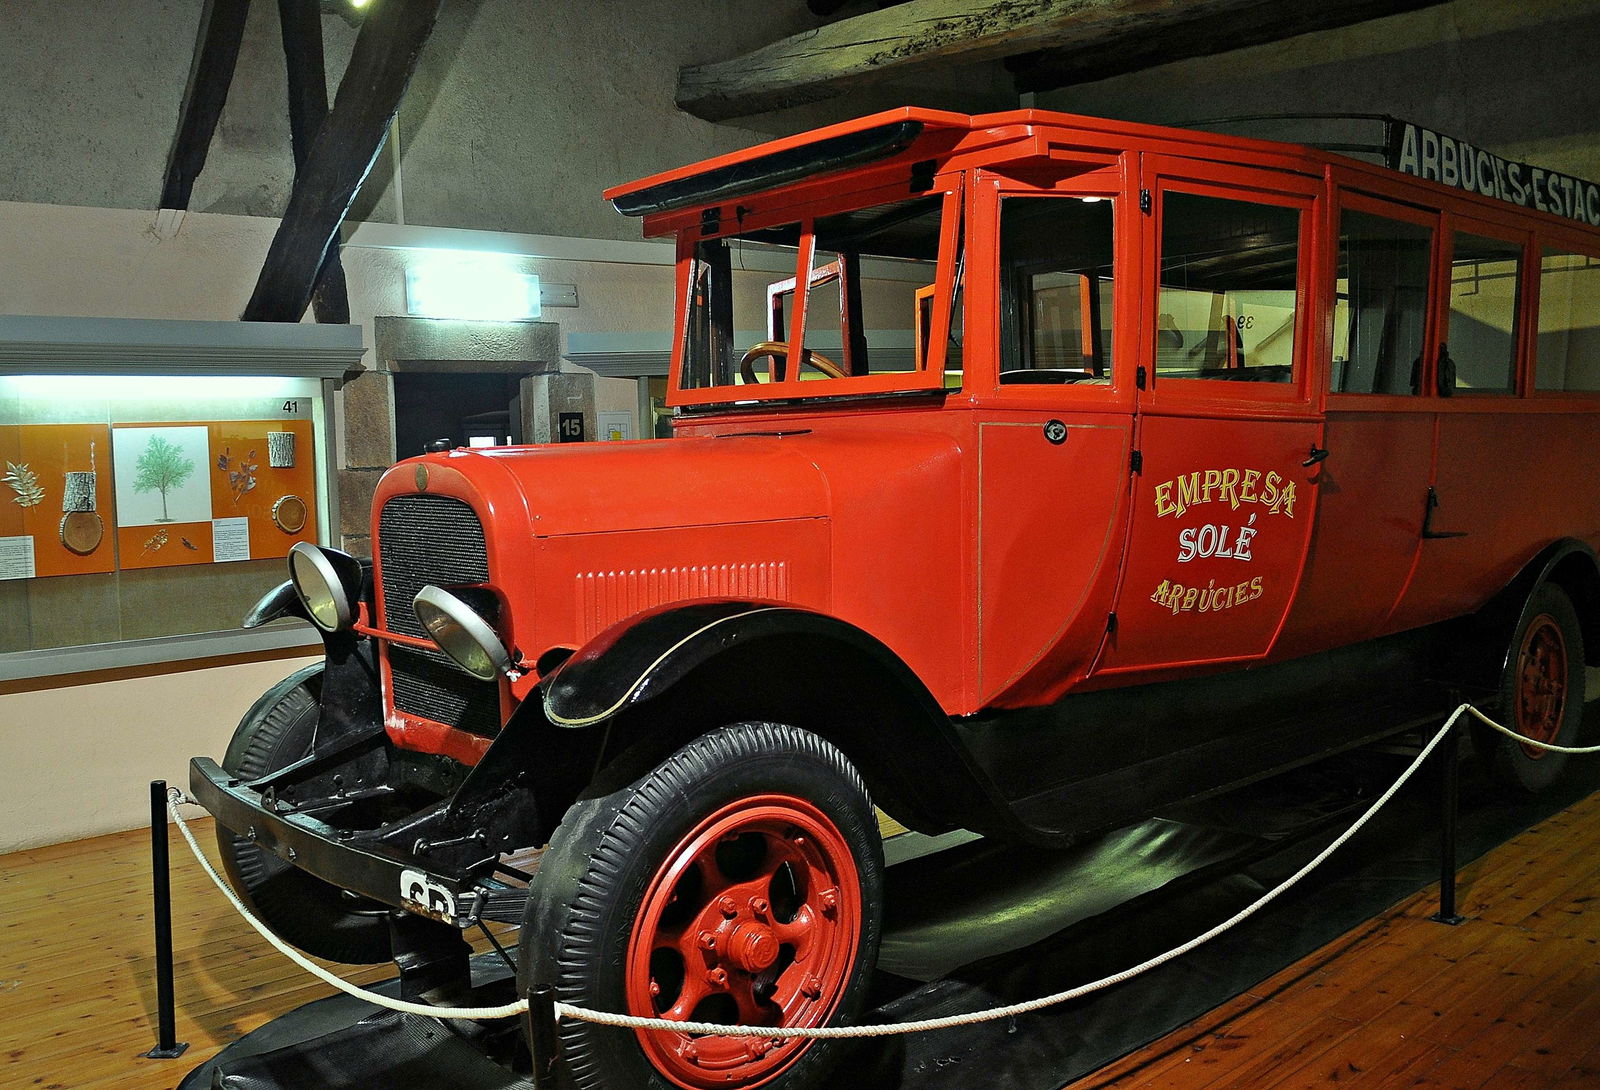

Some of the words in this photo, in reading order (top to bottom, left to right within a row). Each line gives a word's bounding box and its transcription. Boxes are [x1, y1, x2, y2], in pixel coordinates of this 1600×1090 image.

[282, 400, 298, 414] 41
[562, 418, 580, 436] 15
[1154, 468, 1297, 519] EMPRESA
[1177, 512, 1258, 563] SOLÉ
[1150, 575, 1264, 616] ARBÚCIES
